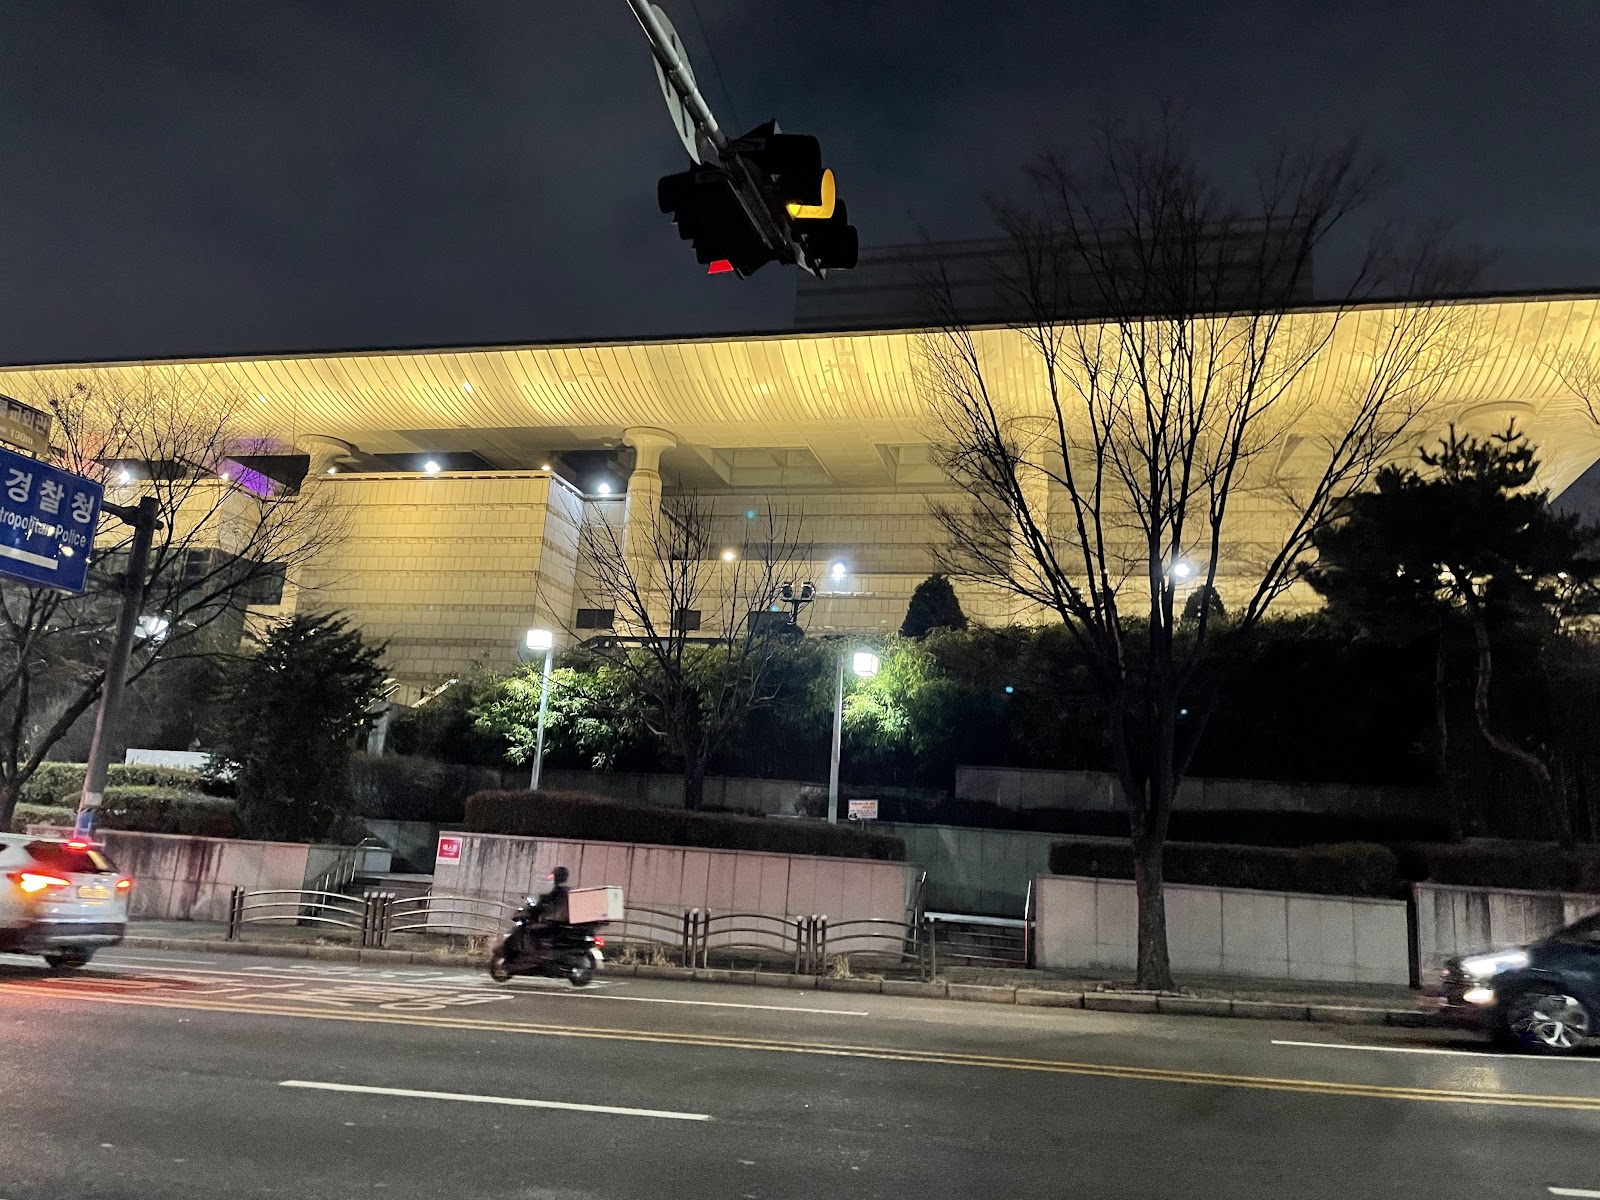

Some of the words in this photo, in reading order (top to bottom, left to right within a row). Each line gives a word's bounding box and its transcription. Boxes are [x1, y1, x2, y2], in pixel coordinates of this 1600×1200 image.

[10, 429, 33, 445] 130m
[5, 468, 95, 524] 경찰청
[55, 524, 87, 547] Police
